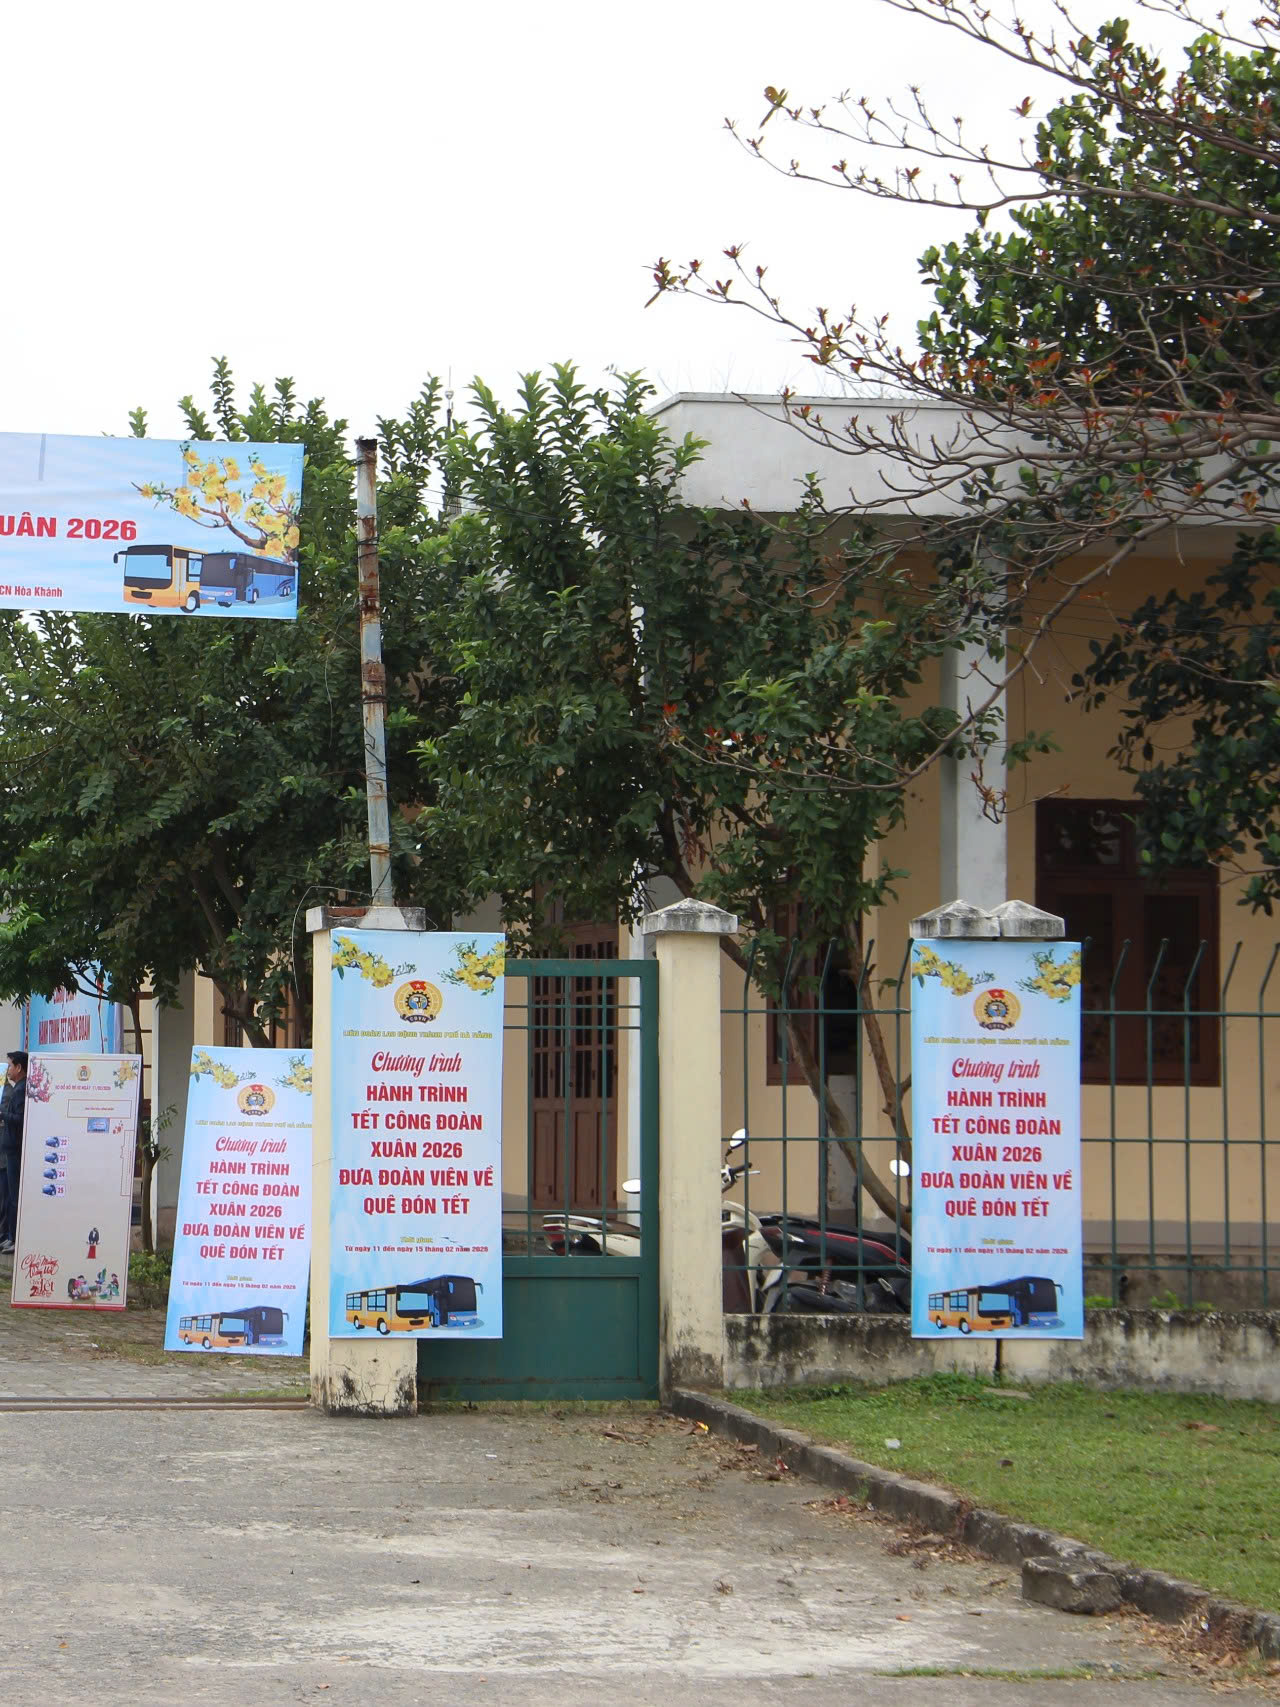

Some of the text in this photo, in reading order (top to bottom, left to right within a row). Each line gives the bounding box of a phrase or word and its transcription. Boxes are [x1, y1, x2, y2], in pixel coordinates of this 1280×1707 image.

[66, 518, 136, 541] 2026
[14, 586, 32, 596] Hòa
[34, 586, 62, 597] Khánh
[371, 1051, 462, 1077] Chương trình
[952, 1058, 1040, 1083] Chương trình
[367, 1082, 467, 1102] HÀNH TRÌNH
[947, 1088, 1046, 1108] HÀNH TRÌNH
[351, 1109, 482, 1130] TẾT CÔNG ĐOÀN
[932, 1114, 1061, 1135] TẾT CÔNG ĐOÀN
[215, 1136, 287, 1156] Chương trình
[371, 1138, 462, 1158] XUÂN 2026
[952, 1142, 1042, 1162] XUÂN 2026
[210, 1159, 289, 1176] HÀNH TRÌNH
[339, 1165, 493, 1186] ĐƯA ĐOÀN VIÊN VỀ
[196, 1179, 299, 1197] TẾT CÔNG ĐOÀN
[921, 1169, 1072, 1190] ĐƯA ĐOÀN VIÊN VỀ
[209, 1201, 282, 1218] XUÂN 2026
[364, 1193, 470, 1215] QUÊ ĐÓN TẾT
[945, 1196, 1049, 1217] QUÊ ĐÓN TẾT
[183, 1223, 209, 1236] ĐƯA
[213, 1223, 250, 1238] ĐOÀN
[255, 1224, 285, 1239] VIÊN
[200, 1243, 284, 1260] QUÊ ĐÓN TẾT
